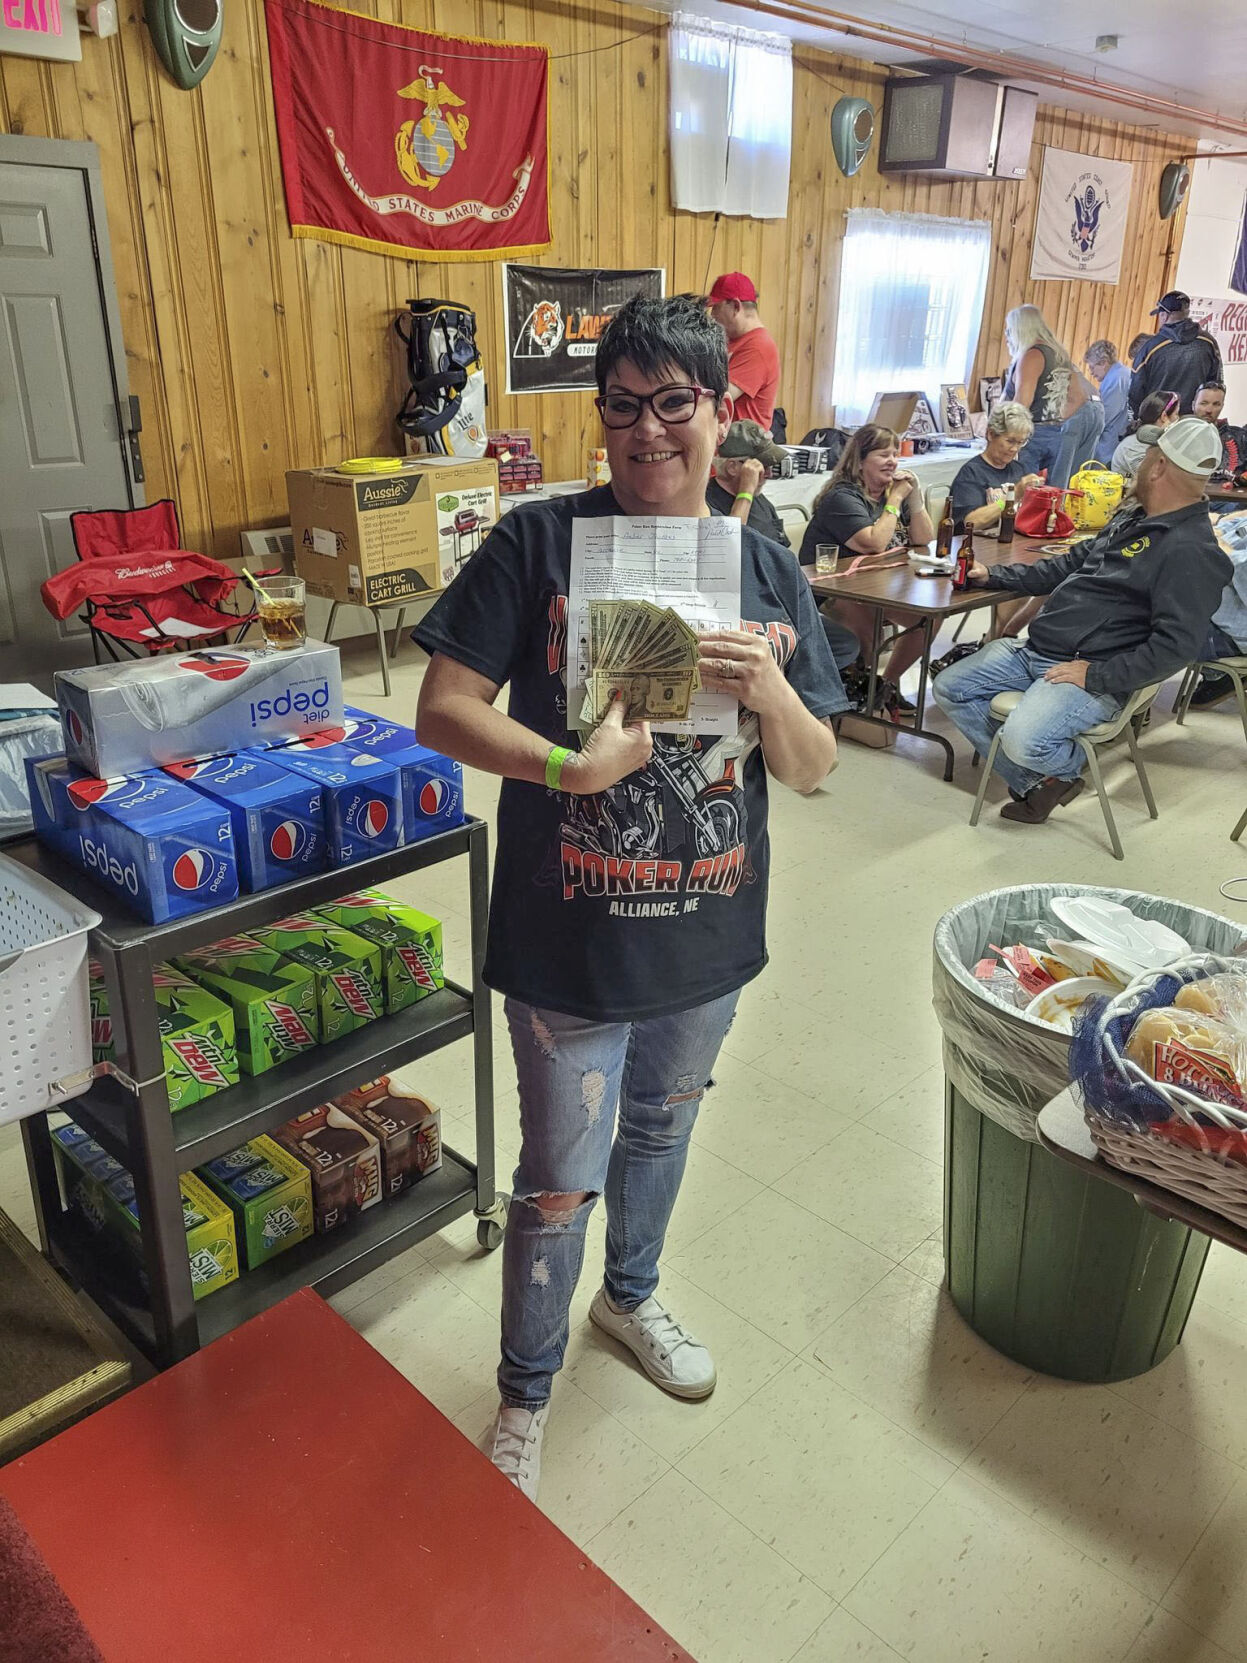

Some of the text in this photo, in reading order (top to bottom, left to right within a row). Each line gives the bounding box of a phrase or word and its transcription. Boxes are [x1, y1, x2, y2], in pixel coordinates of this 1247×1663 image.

[389, 197, 435, 222] STATES
[445, 205, 484, 223] MARINE
[491, 187, 525, 221] CORPS
[1221, 303, 1247, 331] REG
[1228, 333, 1247, 362] HE
[457, 412, 474, 430] Lite
[364, 484, 401, 501] Aussie
[370, 574, 406, 590] ELECTRIC
[370, 582, 416, 600] CART GRILL
[251, 681, 330, 728] pepsi
[304, 709, 330, 725] diet
[364, 728, 399, 746] pepsi
[214, 763, 257, 784] pepsi
[119, 786, 169, 809] pepsi
[346, 796, 360, 825] pepsi
[446, 791, 460, 818] pepsi
[302, 833, 317, 862] pepsi
[79, 834, 139, 896] pepsi
[210, 862, 228, 893] pepsi
[561, 843, 745, 901] POKER RUN
[608, 897, 700, 918] ALLIANCE, NE
[423, 1124, 438, 1164] MUG
[364, 1158, 379, 1199] MUG
[270, 1207, 299, 1235] MIST
[190, 1250, 221, 1280] MIST
